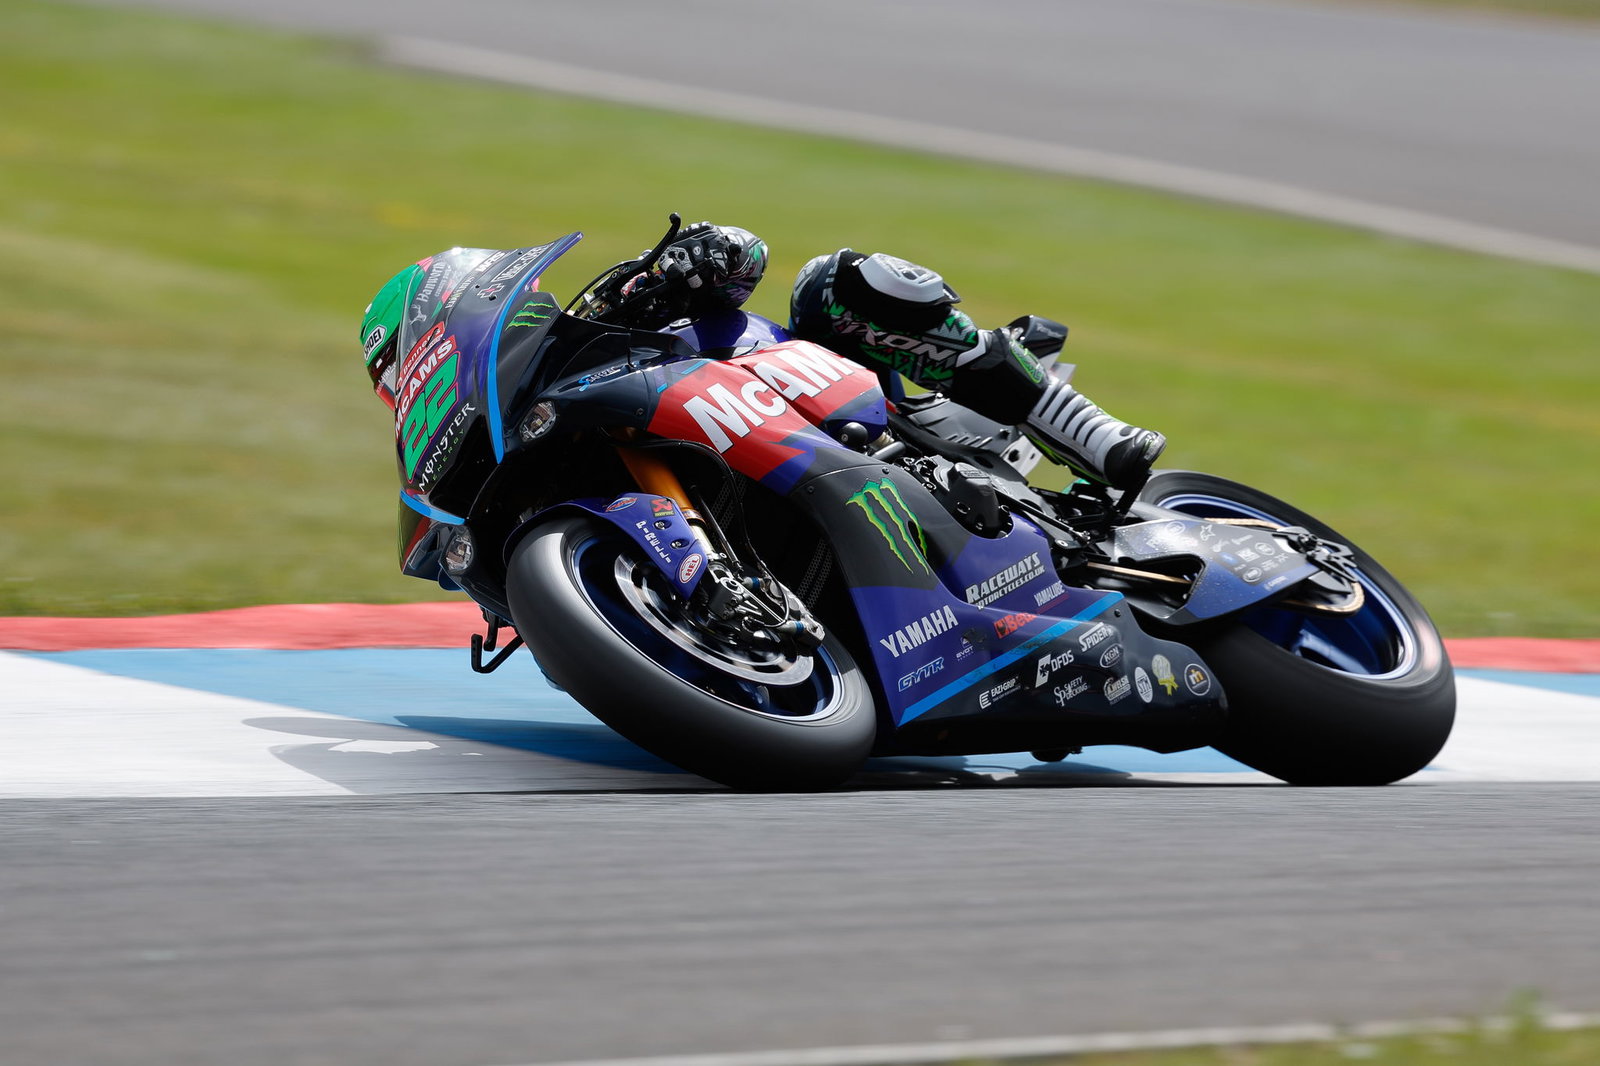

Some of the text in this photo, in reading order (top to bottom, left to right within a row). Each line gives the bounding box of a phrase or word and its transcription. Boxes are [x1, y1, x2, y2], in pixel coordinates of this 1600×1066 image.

[402, 351, 460, 482] 22
[636, 520, 672, 563] PIRELLI
[685, 559, 698, 577] HEL
[965, 551, 1041, 604] RACEWAYS
[1033, 579, 1065, 607] YAMALUBE
[879, 605, 959, 658] YAMAHA
[898, 657, 945, 692] GYTR
[1051, 650, 1074, 672] DFDS
